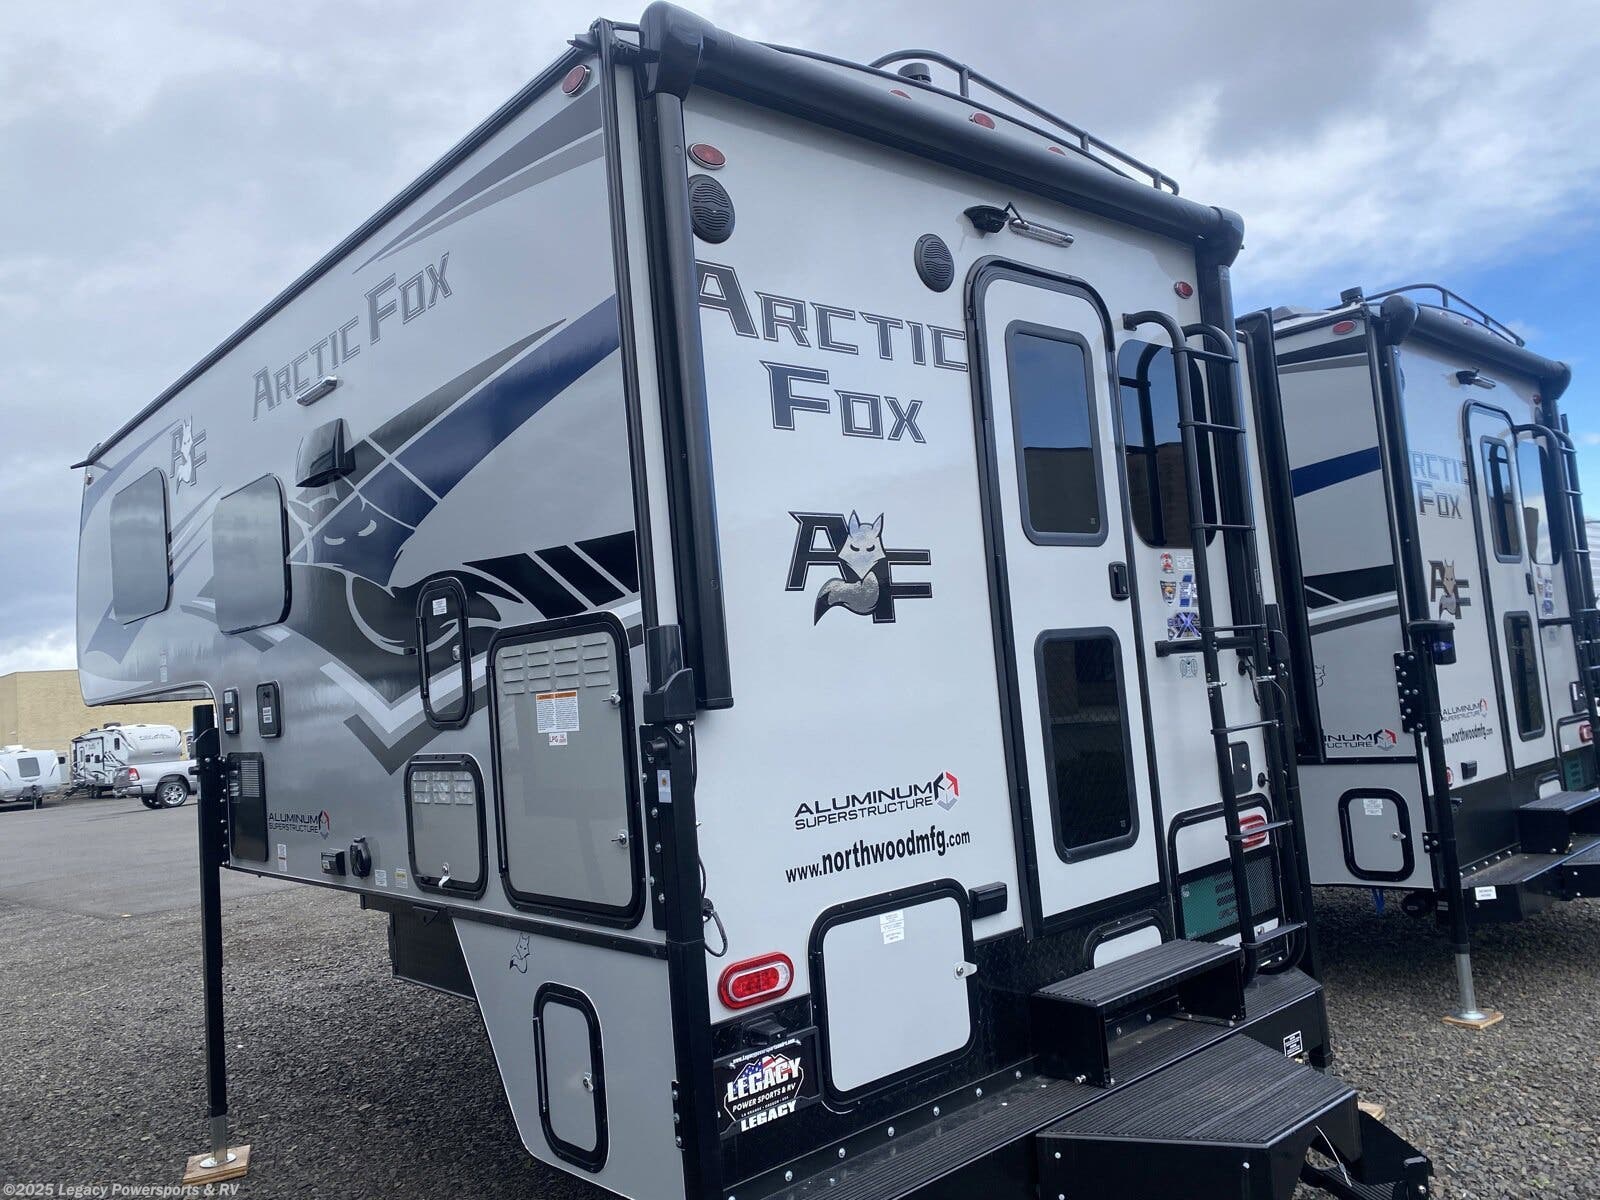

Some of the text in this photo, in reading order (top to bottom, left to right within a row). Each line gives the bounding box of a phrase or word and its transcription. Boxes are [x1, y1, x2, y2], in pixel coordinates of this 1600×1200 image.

[364, 251, 452, 345] FOX
[695, 259, 968, 372] ARCTIC
[759, 360, 926, 443] FOX
[1443, 703, 1480, 716] ALUMINUM
[1324, 734, 1374, 742] INUM
[794, 781, 933, 818] ALUMINUM
[795, 795, 933, 831] SUPERSTRUCTURE
[268, 813, 319, 824] ALUMINUM
[268, 822, 319, 833] SUPERSTRUCTURE
[785, 825, 971, 883] www.northwoodmfg.com
[727, 1057, 801, 1102] LEGACY
[732, 1099, 756, 1113] POWER
[757, 1088, 781, 1104] SPORTS
[787, 1082, 797, 1092] RV
[740, 1100, 797, 1132] LEGACY
